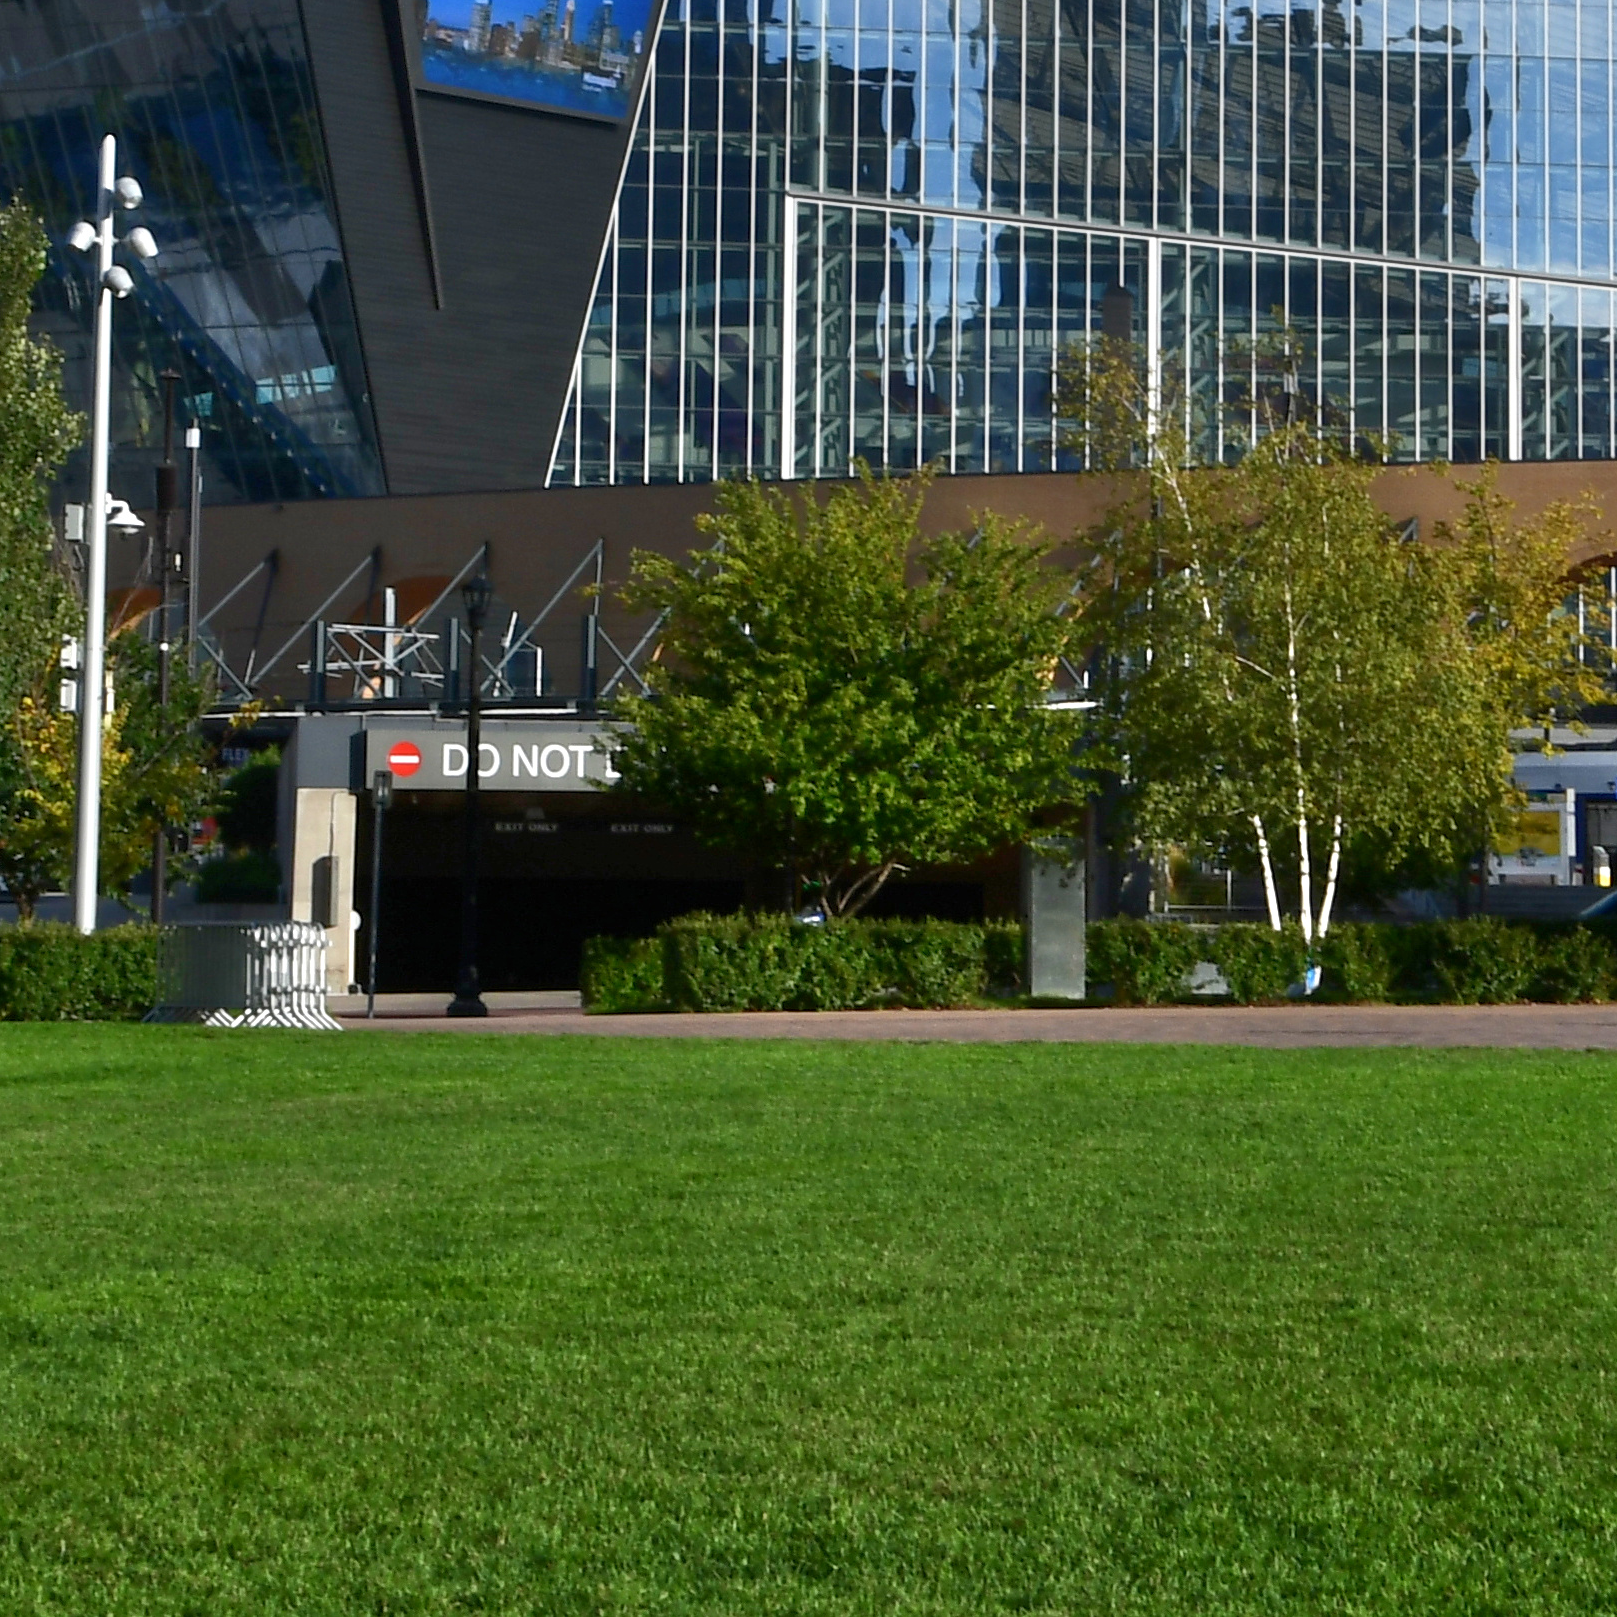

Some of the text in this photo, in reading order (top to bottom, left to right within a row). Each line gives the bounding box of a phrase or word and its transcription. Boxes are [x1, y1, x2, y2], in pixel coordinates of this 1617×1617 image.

[442, 743, 501, 778] DO
[512, 743, 594, 779] NOT
[495, 822, 559, 833] EXIT ONLY
[610, 823, 675, 833] EXIT ONLY
